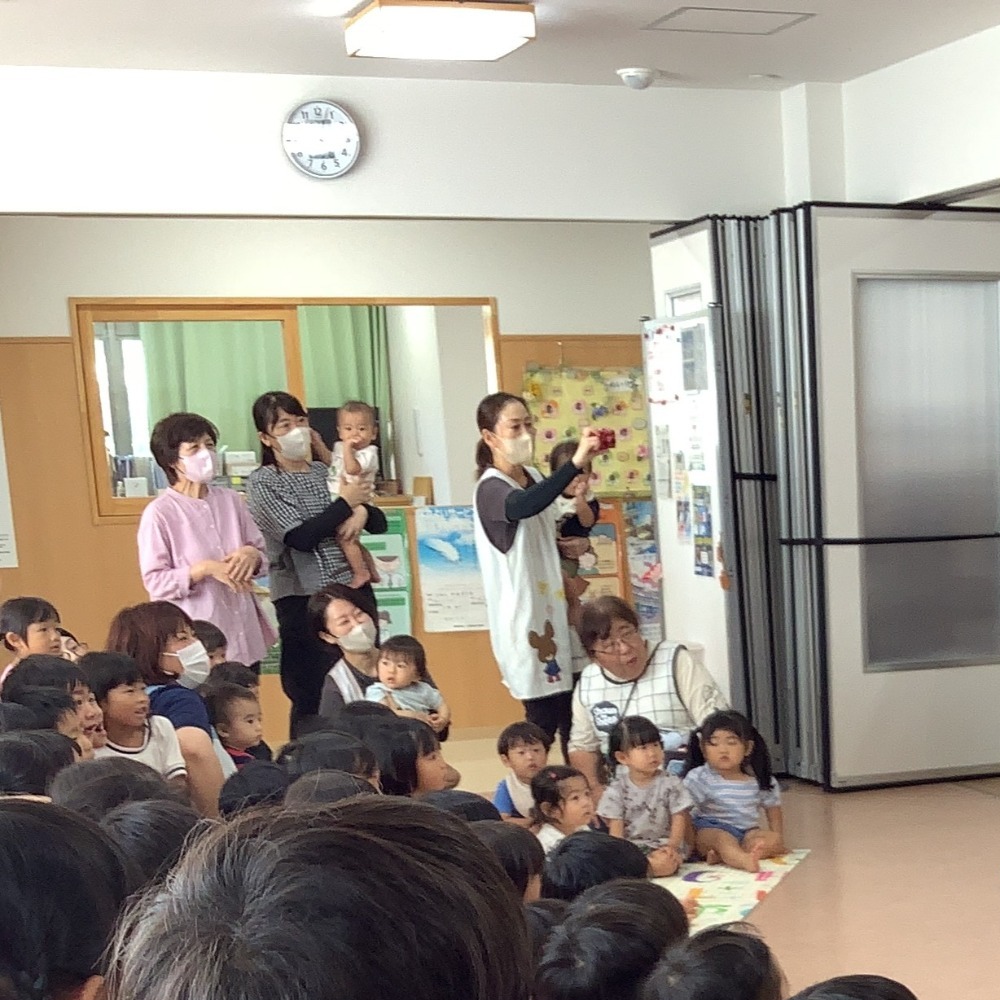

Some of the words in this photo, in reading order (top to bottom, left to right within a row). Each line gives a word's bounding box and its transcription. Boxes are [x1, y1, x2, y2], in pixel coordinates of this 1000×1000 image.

[301, 111, 309, 119] 11
[313, 107, 322, 116] 12
[330, 110, 335, 119] 1
[320, 162, 327, 171] 6
